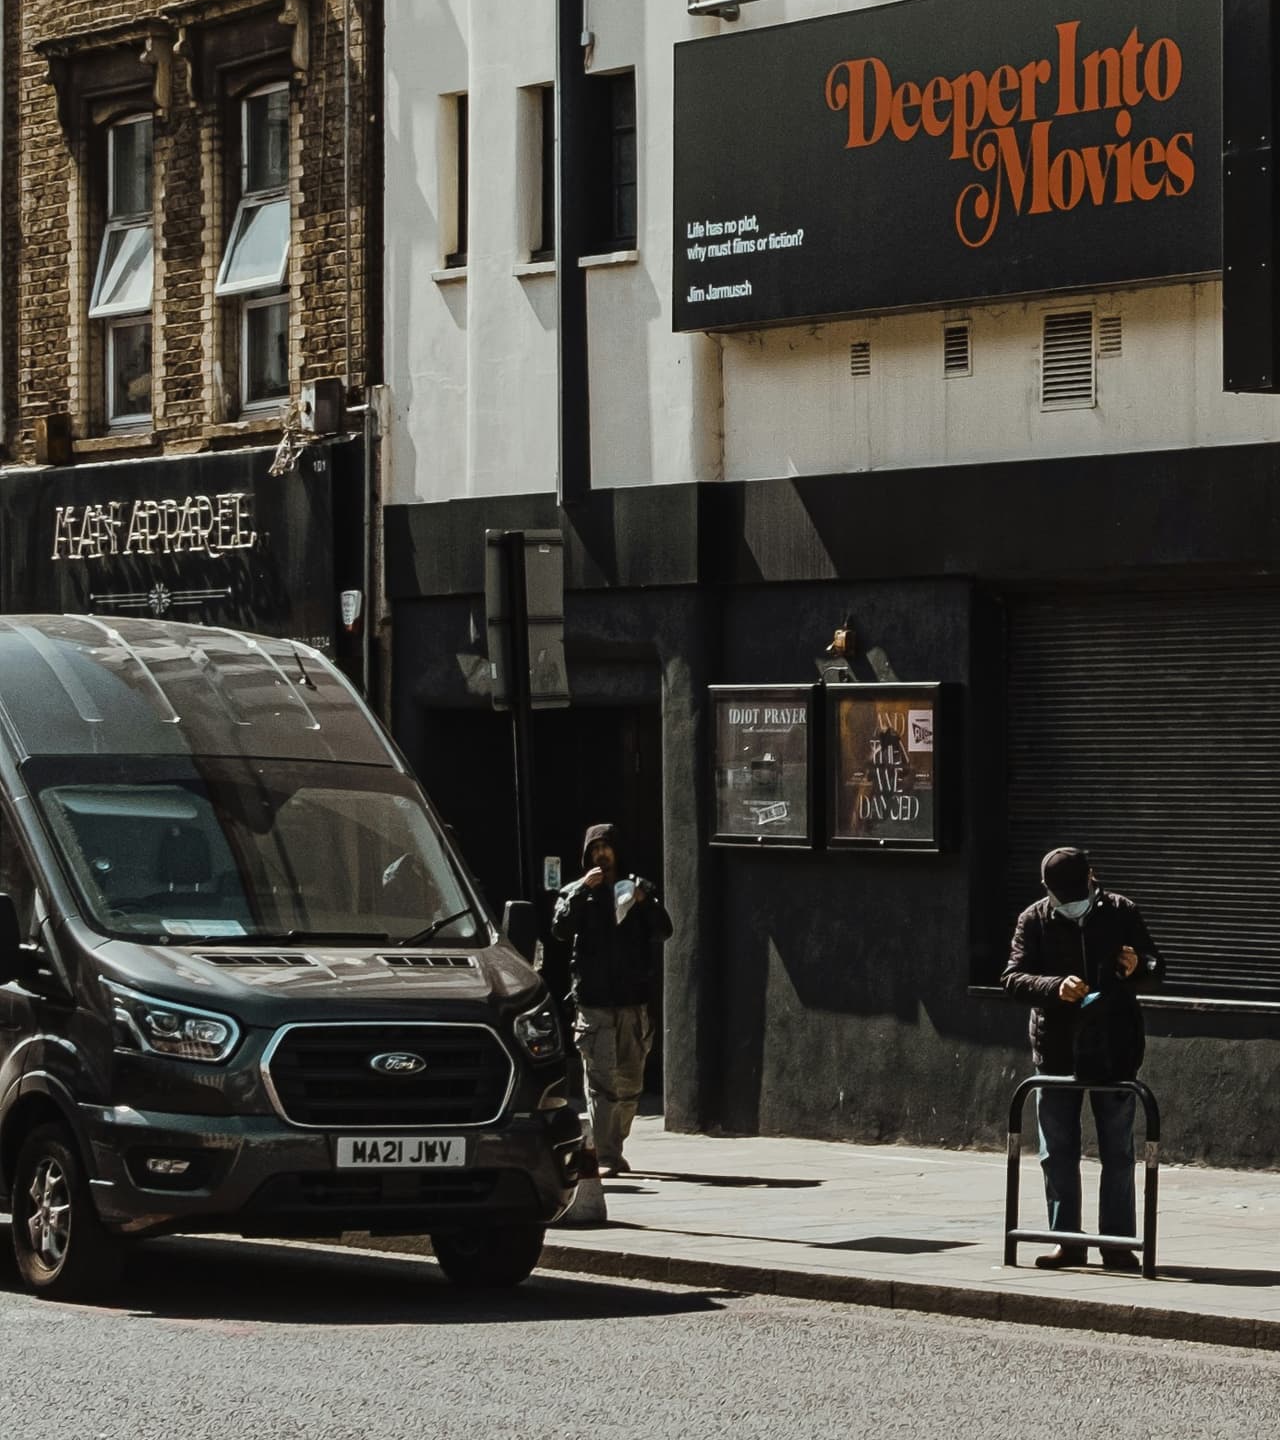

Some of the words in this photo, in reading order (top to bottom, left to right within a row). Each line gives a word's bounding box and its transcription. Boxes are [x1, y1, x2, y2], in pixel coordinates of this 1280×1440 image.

[824, 56, 1052, 161] Deeper
[1053, 20, 1184, 117] Into
[954, 108, 1196, 249] Movies
[686, 221, 705, 239] Life
[705, 220, 724, 237] has
[724, 220, 737, 234] no
[738, 214, 759, 236] plot,
[686, 242, 706, 263] why
[707, 239, 732, 258] must
[732, 237, 756, 255] films
[756, 237, 767, 252] or
[768, 228, 804, 250] fiction?
[686, 285, 705, 303] Jim
[705, 279, 752, 301] Jarmusch
[123, 493, 258, 558] APPAREL
[728, 708, 760, 725] IDIOT
[764, 707, 807, 724] PRAYER
[385, 1055, 416, 1070] Ford
[352, 1140, 403, 1163] MA21
[409, 1140, 452, 1163] JWV
